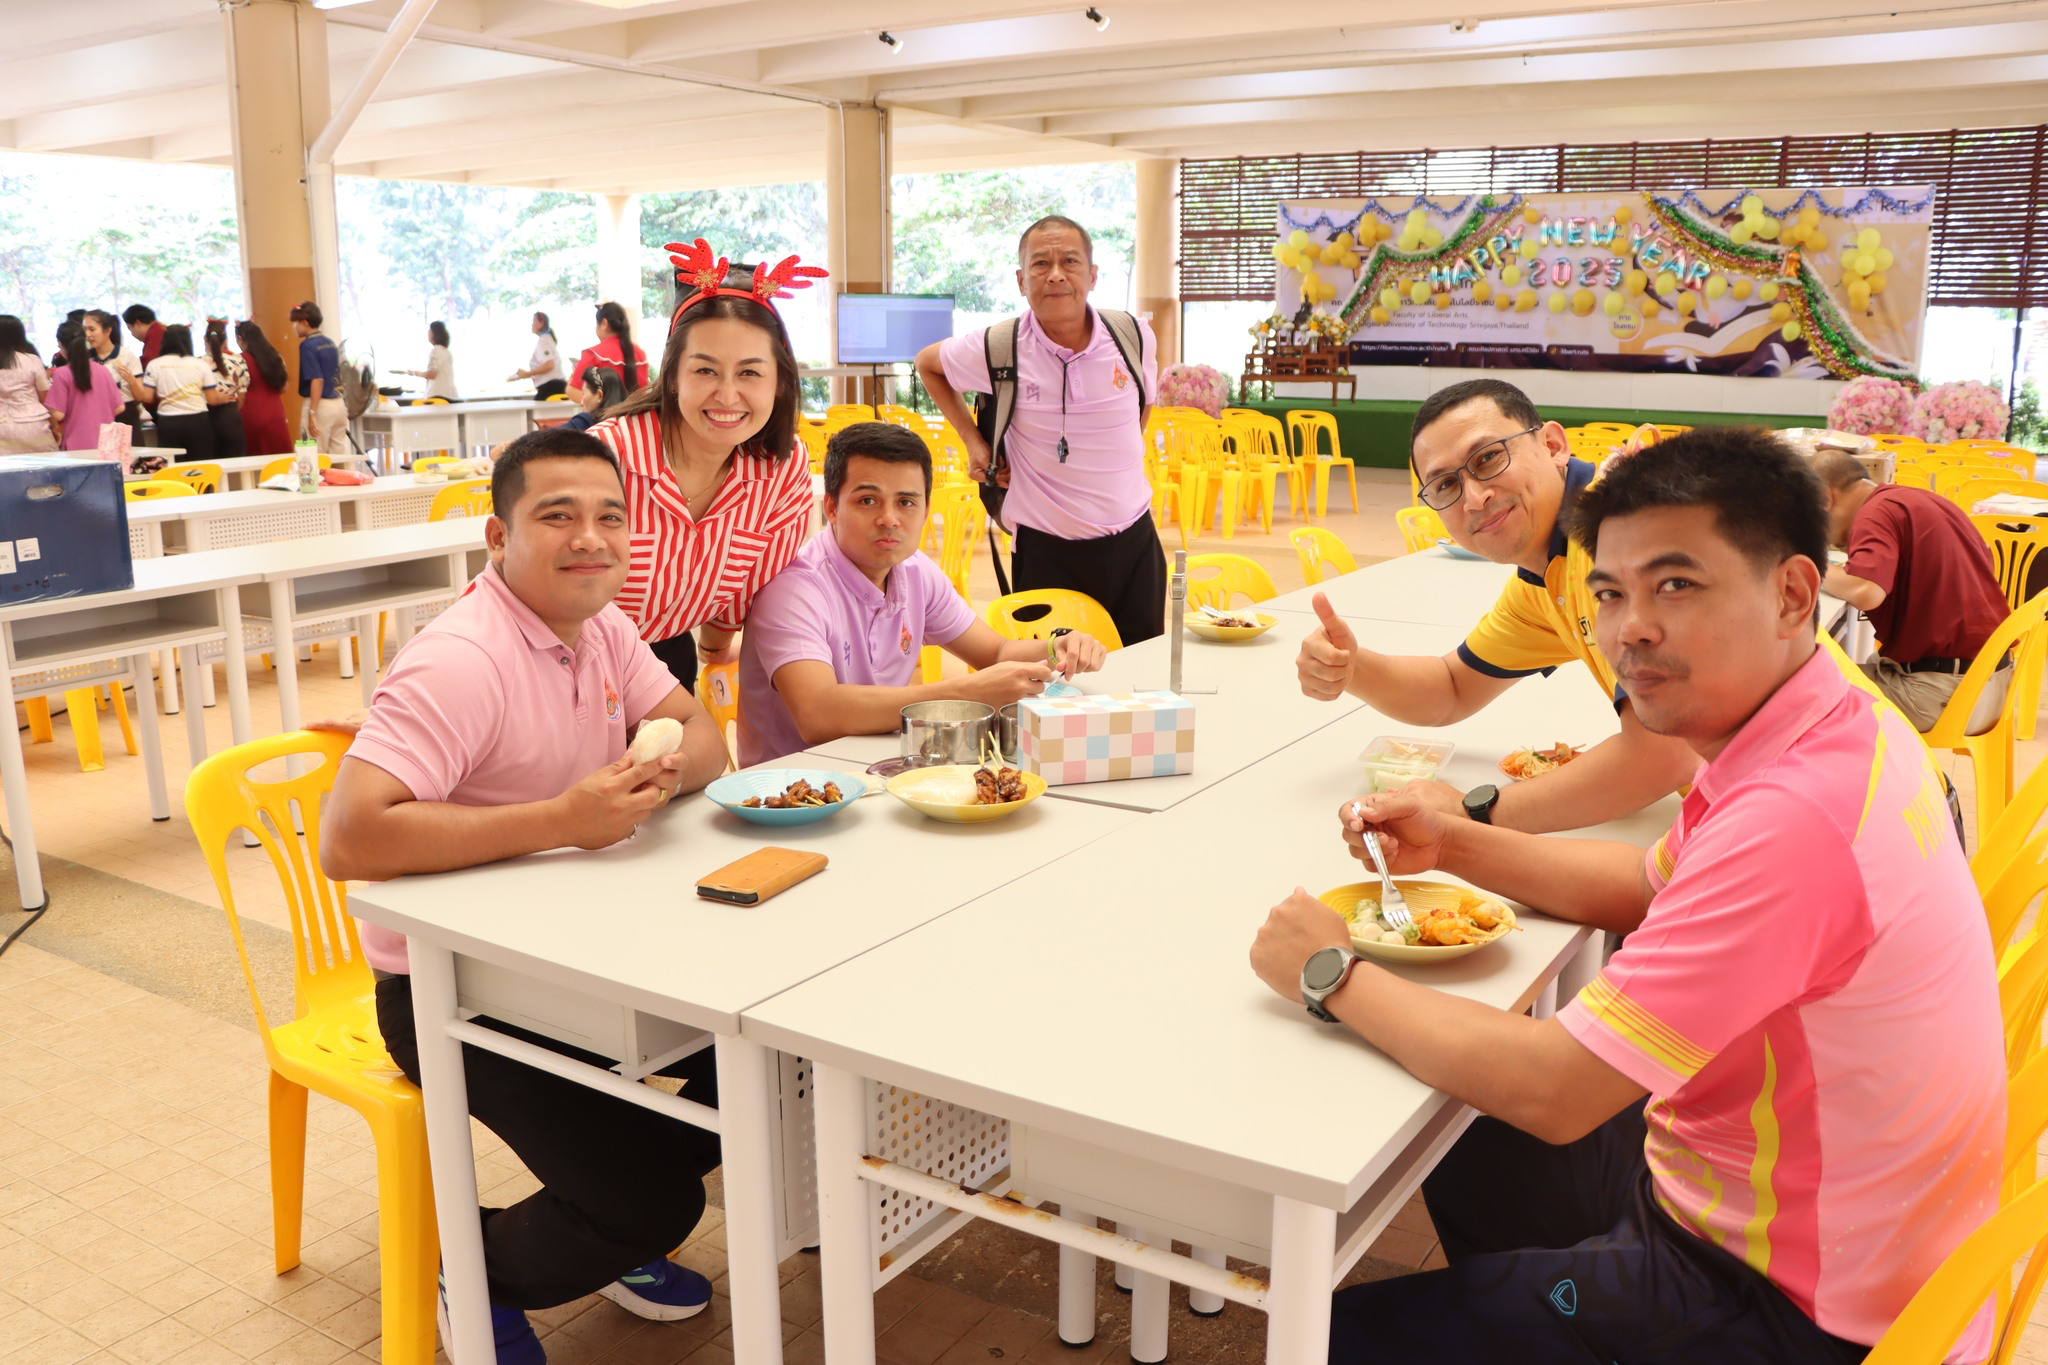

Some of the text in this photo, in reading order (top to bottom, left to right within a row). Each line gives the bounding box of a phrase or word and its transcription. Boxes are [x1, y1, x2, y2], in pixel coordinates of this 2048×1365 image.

[1430, 215, 1712, 294] HAPPY NEW YEAR
[1527, 257, 1624, 291] 2025
[1392, 311, 1416, 320] Faculty
[1418, 311, 1427, 319] of
[1428, 311, 1452, 320] Liberal
[1418, 320, 1427, 329] of
[1428, 320, 1468, 330] Technology
